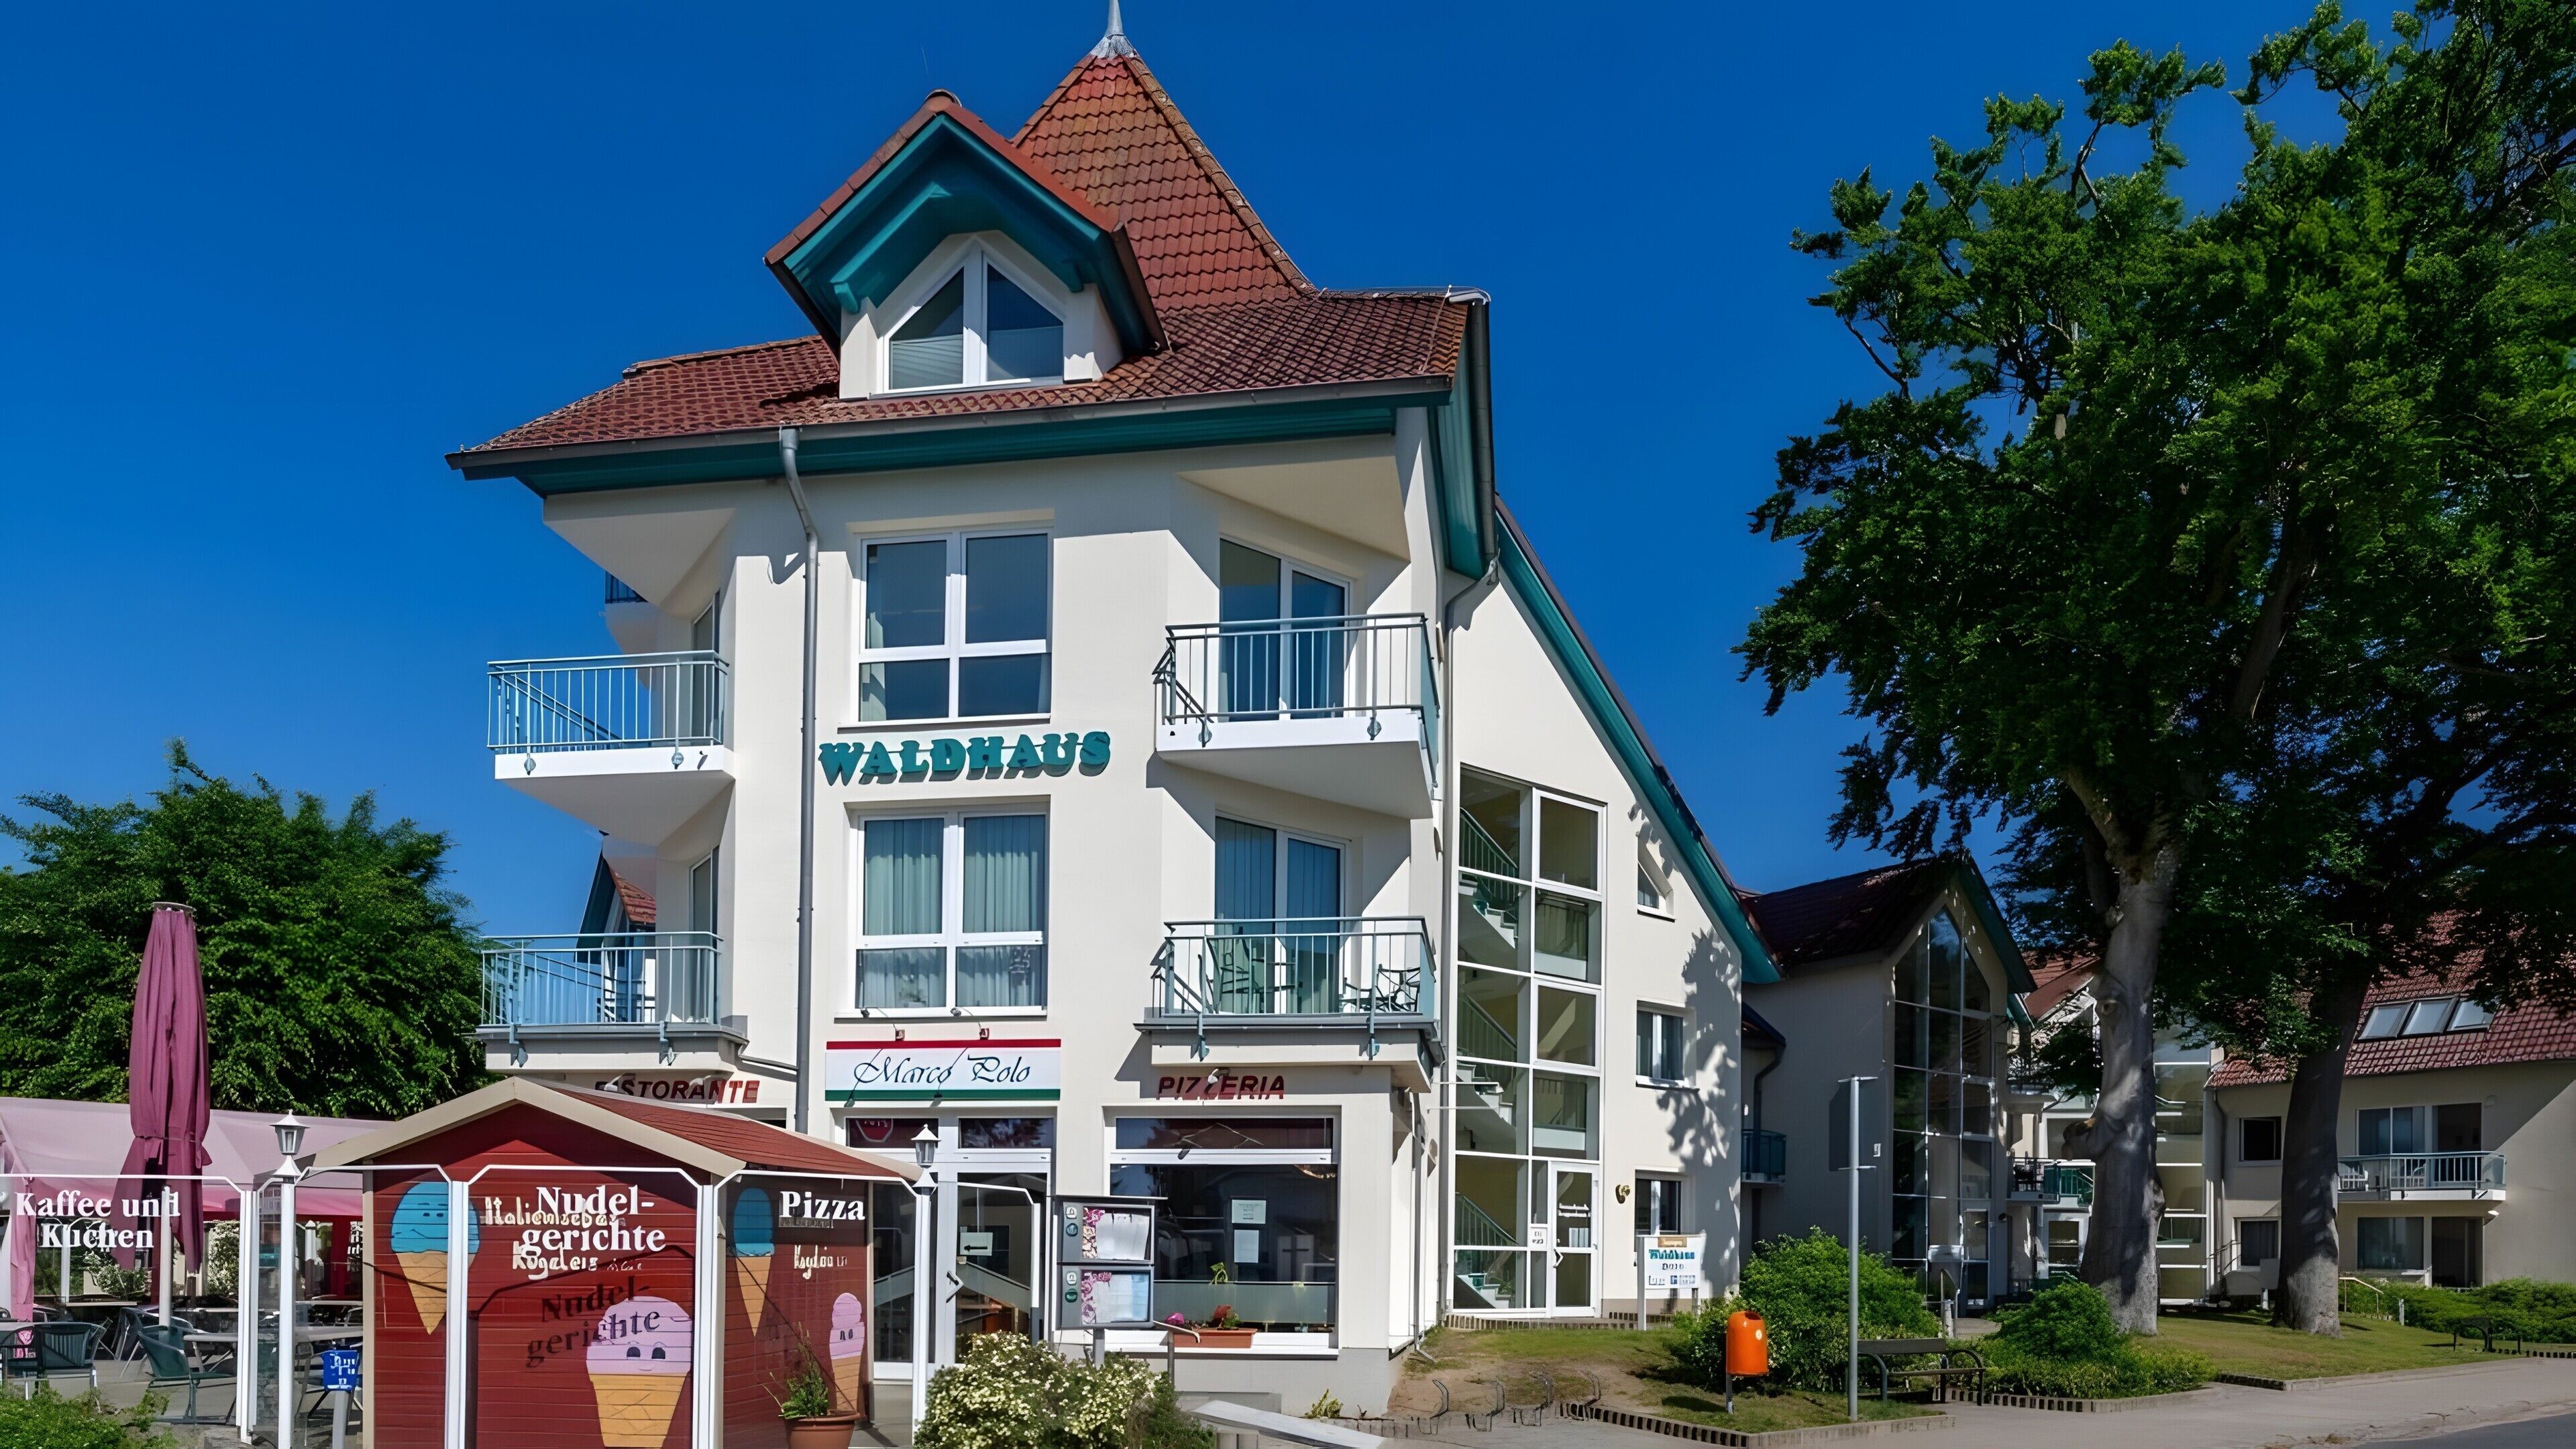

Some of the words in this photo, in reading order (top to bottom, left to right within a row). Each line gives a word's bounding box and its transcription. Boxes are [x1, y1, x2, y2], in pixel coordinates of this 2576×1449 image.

[818, 731, 1111, 786] WALDHAUS
[854, 1056, 951, 1084] Marco
[967, 1054, 1030, 1083] Polo
[595, 1079, 760, 1104] STORANTE
[1157, 1075, 1285, 1100] PIZZERIA
[15, 1189, 111, 1217] Kaffee
[122, 1190, 180, 1218] und
[536, 1185, 655, 1215] Nudel-
[779, 1191, 866, 1220] Pizza
[521, 1222, 666, 1258] gerichte
